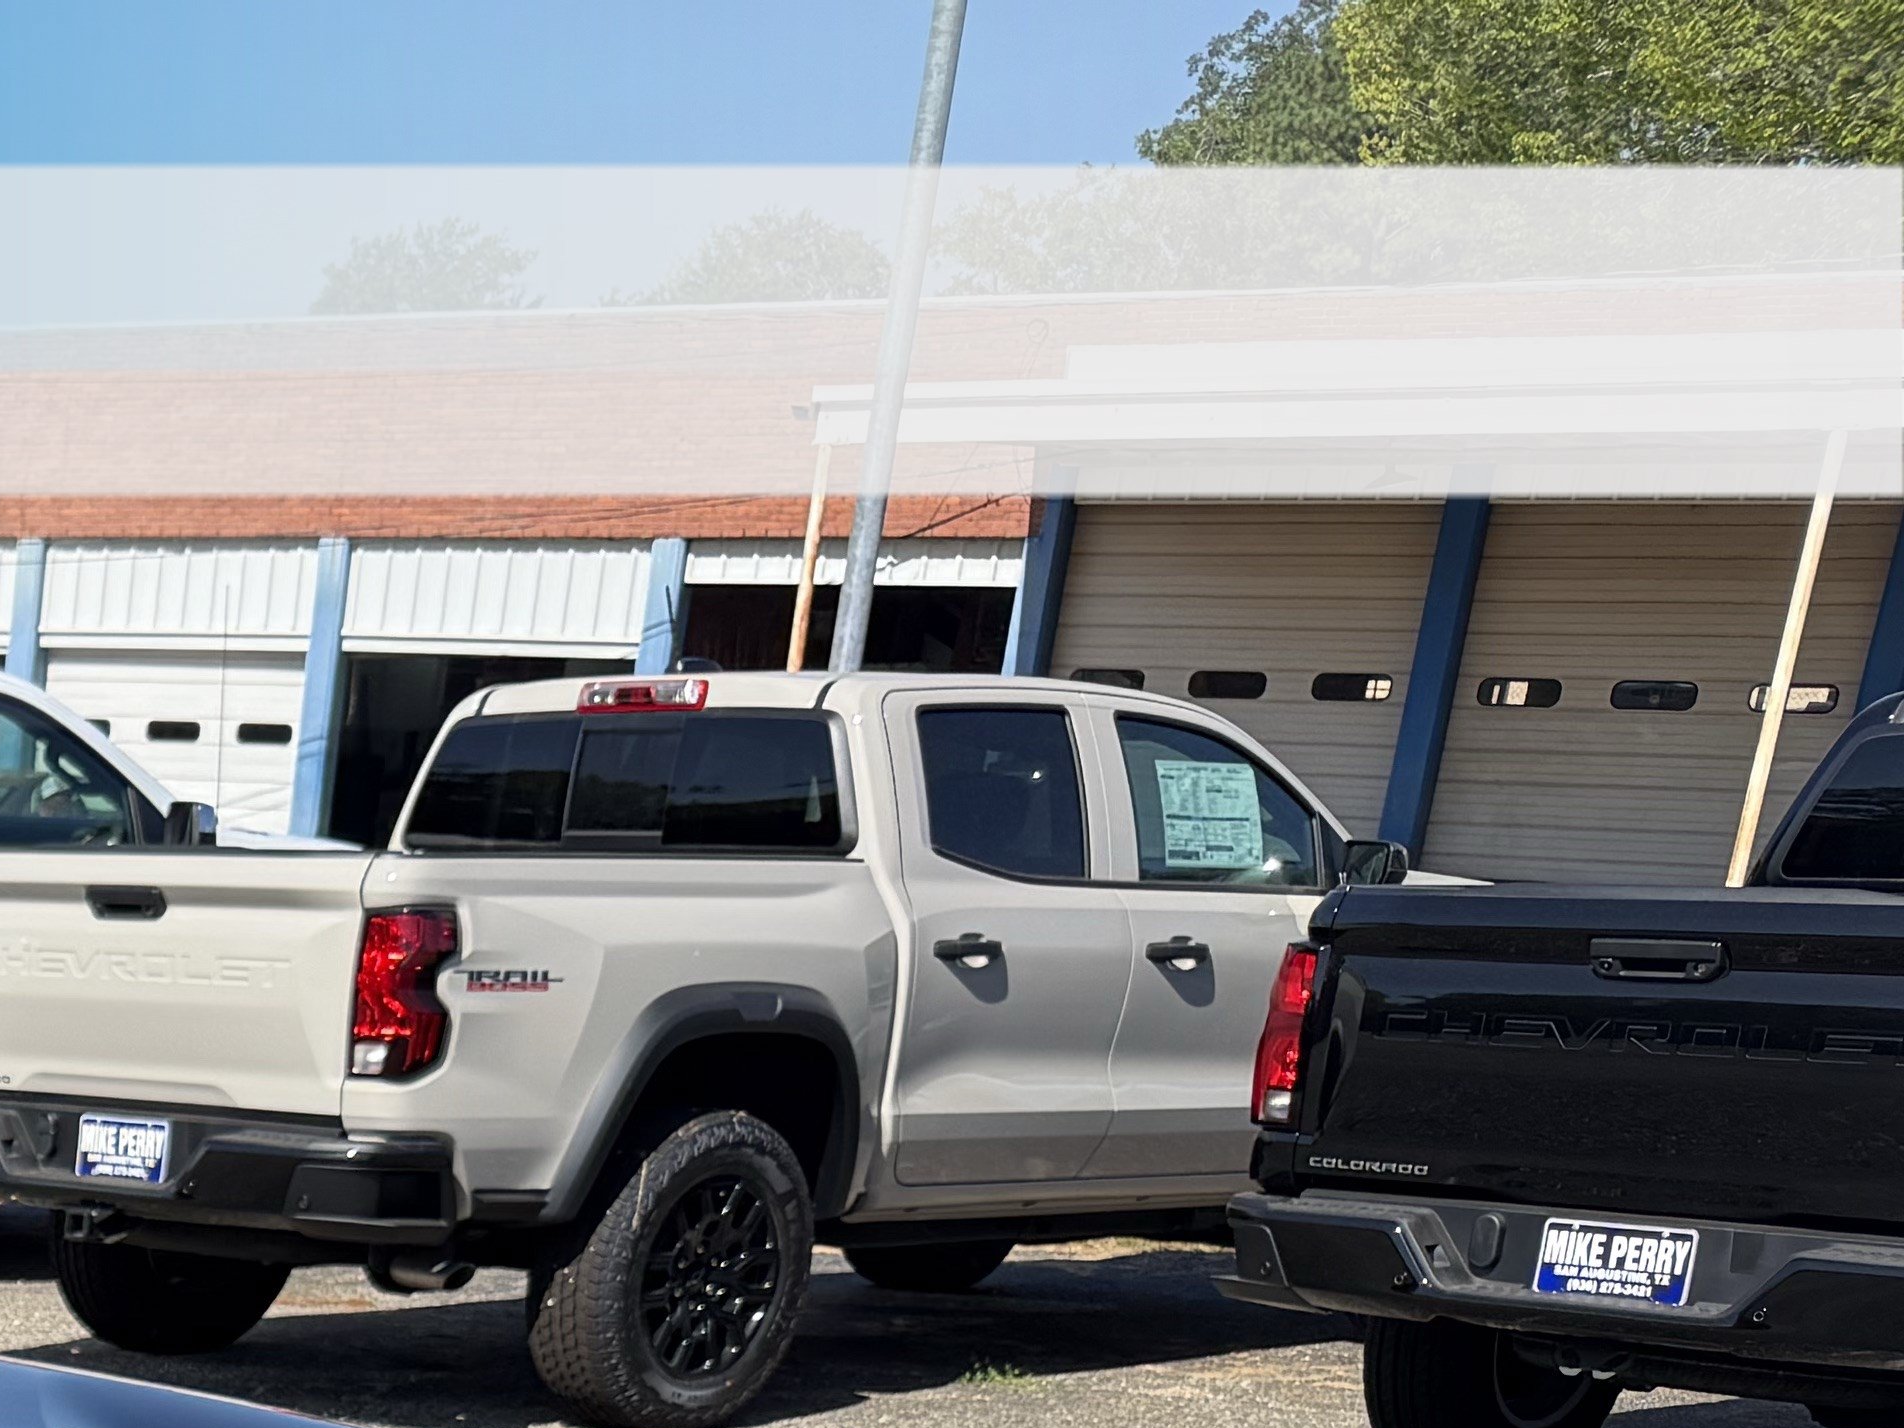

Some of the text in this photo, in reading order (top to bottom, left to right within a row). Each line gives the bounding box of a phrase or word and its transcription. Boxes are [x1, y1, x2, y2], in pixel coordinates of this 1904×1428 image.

[453, 970, 565, 983] TRAIL
[1374, 1009, 1904, 1067] CHEVROLE
[81, 1124, 165, 1160] MIKE PERRY
[1309, 1156, 1429, 1176] COLORADO
[1544, 1229, 1692, 1276] MIKE PERRY
[1553, 1264, 1579, 1277] SAN
